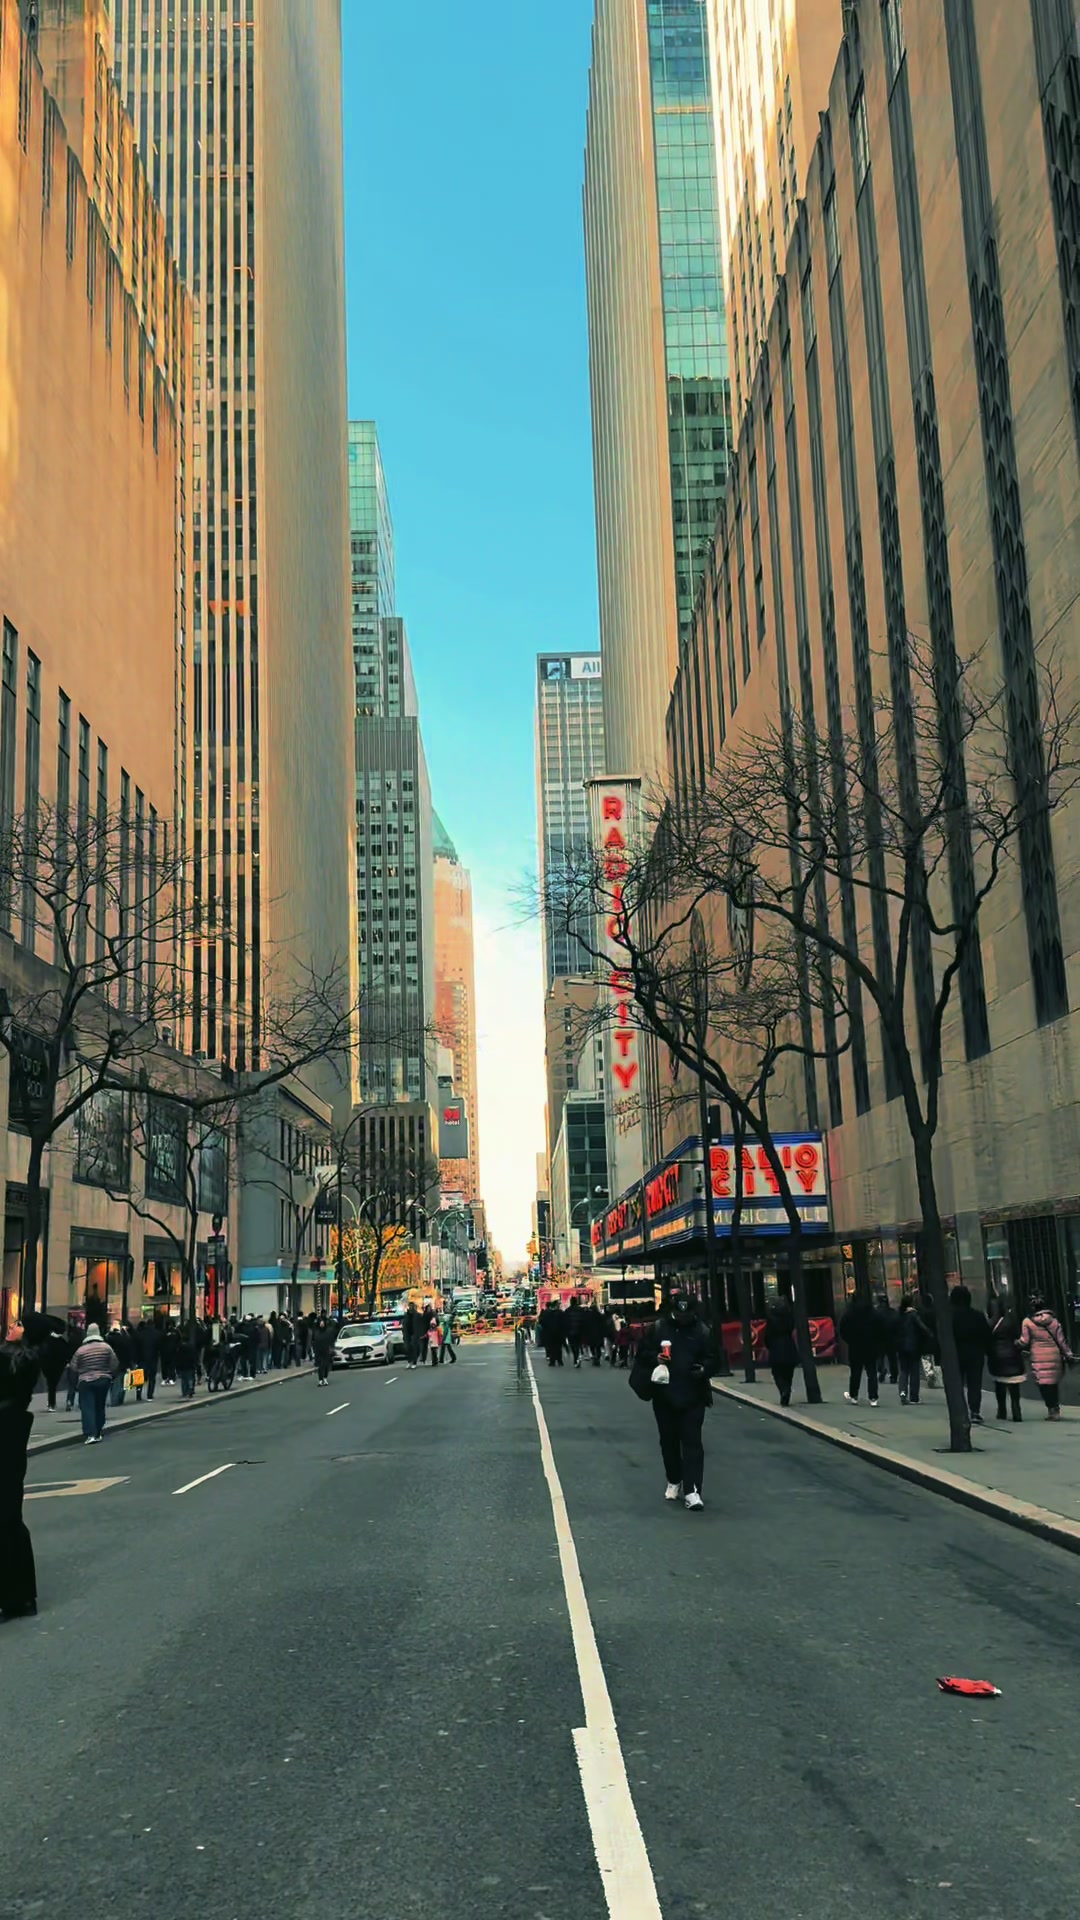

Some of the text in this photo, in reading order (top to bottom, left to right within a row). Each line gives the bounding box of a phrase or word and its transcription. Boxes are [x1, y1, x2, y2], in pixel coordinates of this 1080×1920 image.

[582, 661, 600, 674] All
[609, 969, 639, 1089] CITY
[711, 1169, 819, 1197] CITY
[776, 1206, 825, 1224] HLL
